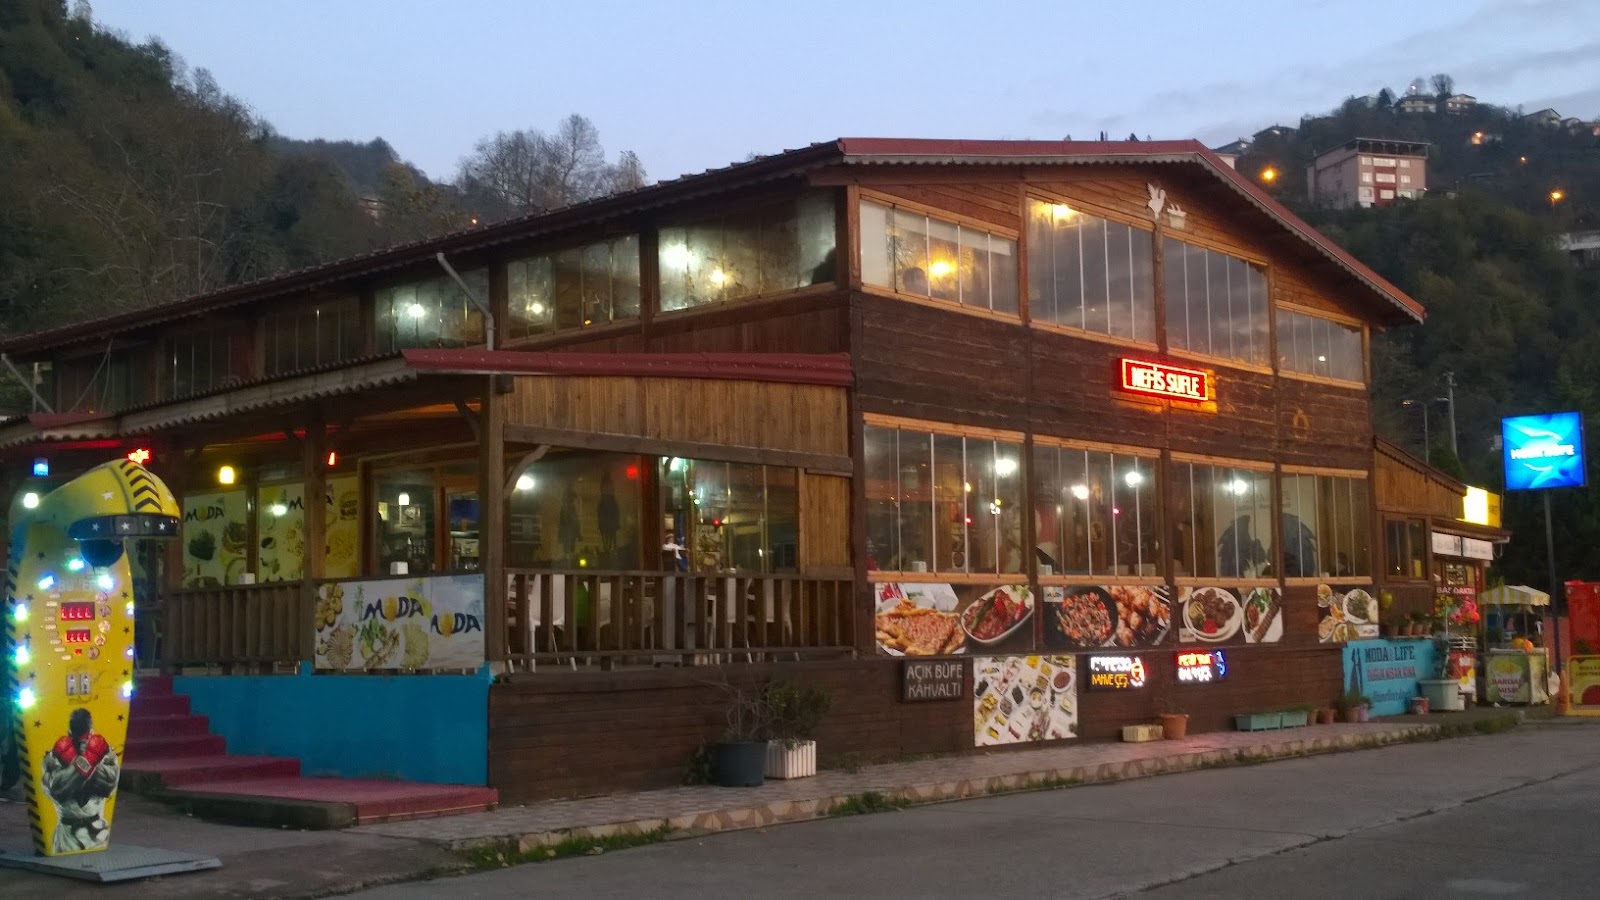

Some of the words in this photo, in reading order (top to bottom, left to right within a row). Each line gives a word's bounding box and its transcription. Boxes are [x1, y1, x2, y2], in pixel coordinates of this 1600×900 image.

[1166, 373, 1200, 397] SUFLE
[363, 595, 423, 622] MODA
[1394, 645, 1415, 662] LIFE
[906, 665, 932, 682] AÇIK
[935, 662, 963, 679] BÜFE
[908, 683, 961, 698] KAHVALTI
